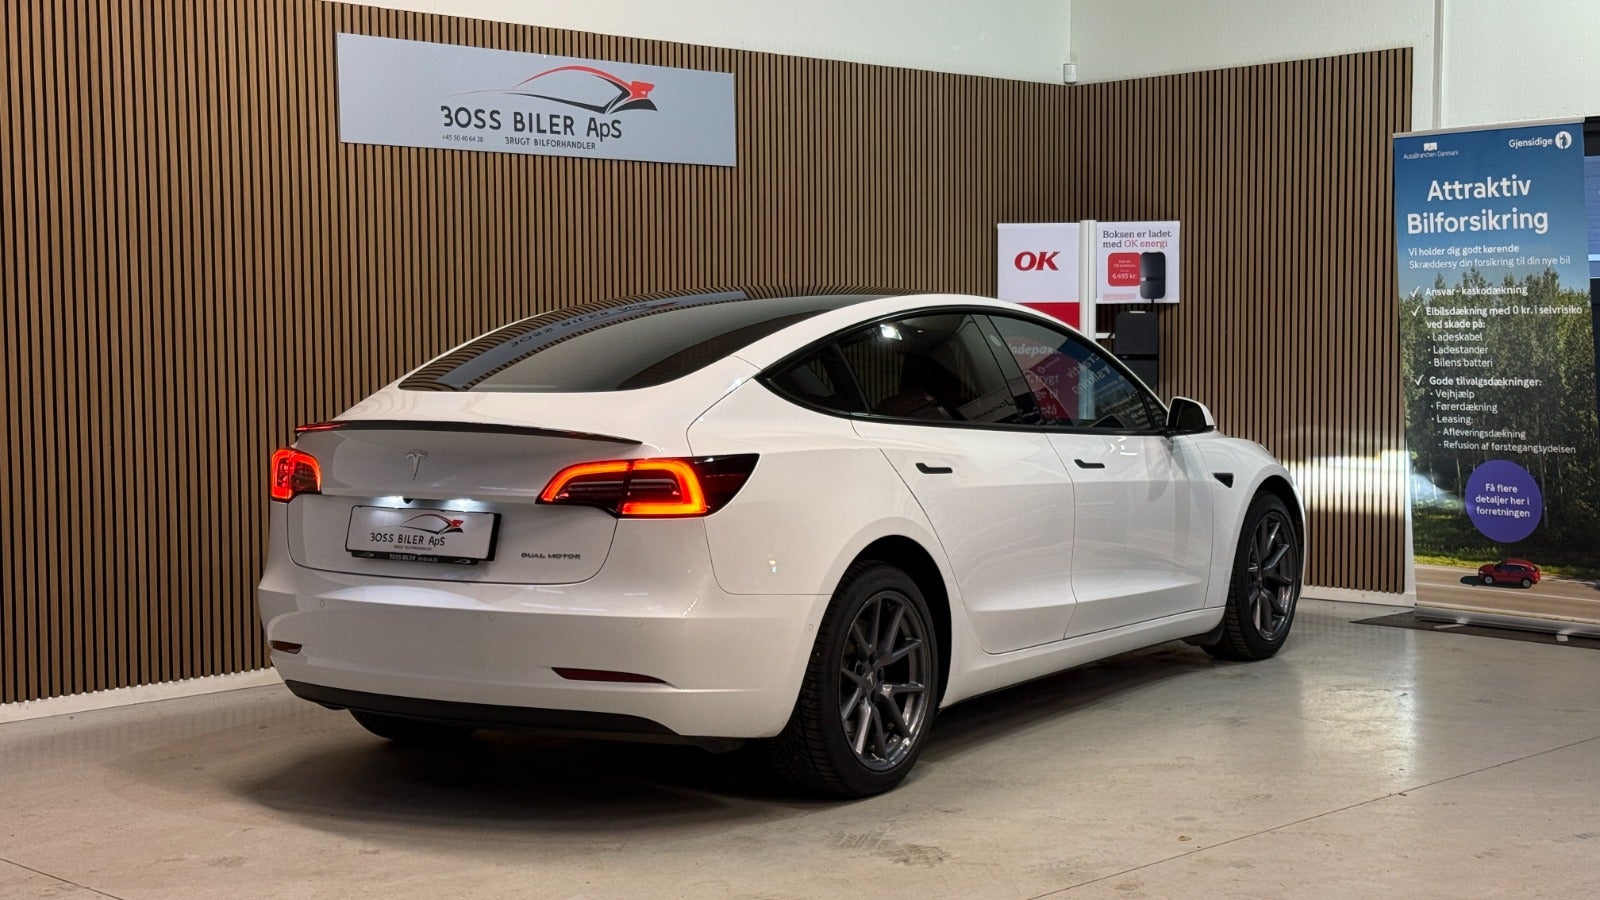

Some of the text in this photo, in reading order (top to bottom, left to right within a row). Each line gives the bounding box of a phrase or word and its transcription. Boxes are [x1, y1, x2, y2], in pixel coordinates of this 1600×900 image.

[513, 112, 575, 136] BILER
[586, 117, 622, 142] ApS
[533, 138, 596, 150] BILFORHANDLER
[1508, 137, 1553, 149] Gjensidige
[1427, 174, 1532, 202] Attraktiv
[1407, 207, 1548, 235] Bilforsikring
[1102, 230, 1135, 239] Boksen
[1148, 229, 1172, 238] ladet
[1102, 239, 1168, 250] med OK energi
[1408, 244, 1520, 256] Vi holder dig godt kørende
[1014, 251, 1061, 271] OK
[1408, 255, 1571, 270] Skræddersy din forsikring til din nye bil
[1461, 285, 1528, 297] kaskodækning
[1426, 306, 1488, 318] Elbilsdækning
[1489, 306, 1511, 315] med
[1512, 305, 1519, 315] 0
[1521, 305, 1533, 315] kr.
[1539, 304, 1583, 315] selvrisiko
[1426, 319, 1486, 330] ved skade på:
[1432, 332, 1483, 342] Ladeskabel
[1433, 345, 1488, 354] Ladestander
[1433, 358, 1494, 367] Bilens batteri
[1429, 376, 1454, 386] Gode
[1435, 389, 1475, 400] Vejhjælp
[1436, 402, 1498, 413] Førerdækning
[1443, 428, 1526, 439] Afleveringsdækning
[1443, 441, 1577, 454] Refusion af førstegangsydelsen
[1485, 483, 1518, 493] Få flere
[1475, 495, 1508, 506] detaljer
[1510, 497, 1526, 505] her
[1476, 506, 1531, 519] forretningen
[397, 533, 424, 545] BILER
[427, 536, 446, 548] ApS
